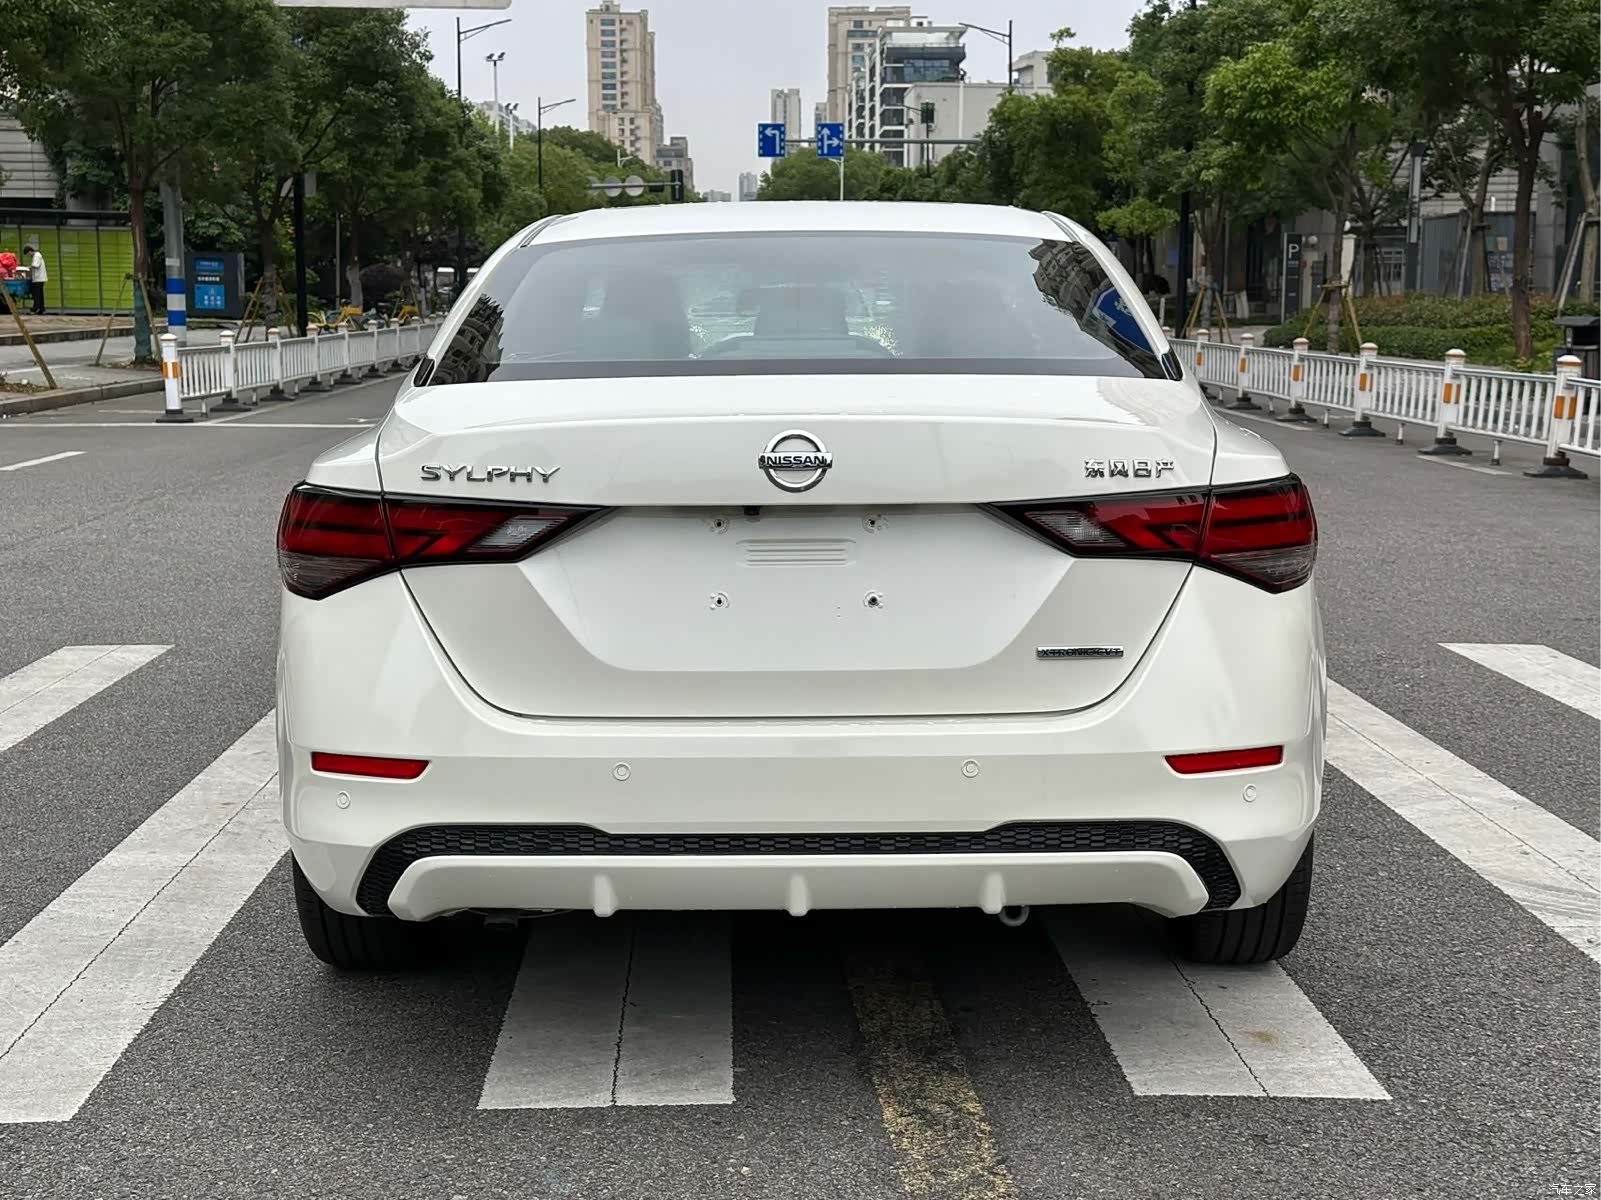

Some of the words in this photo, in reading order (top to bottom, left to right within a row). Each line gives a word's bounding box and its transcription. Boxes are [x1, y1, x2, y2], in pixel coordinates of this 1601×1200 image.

[1288, 243, 1300, 259] P
[766, 455, 825, 466] NISSAN
[1084, 458, 1175, 478] 东风日产
[420, 464, 561, 483] SYLPHY
